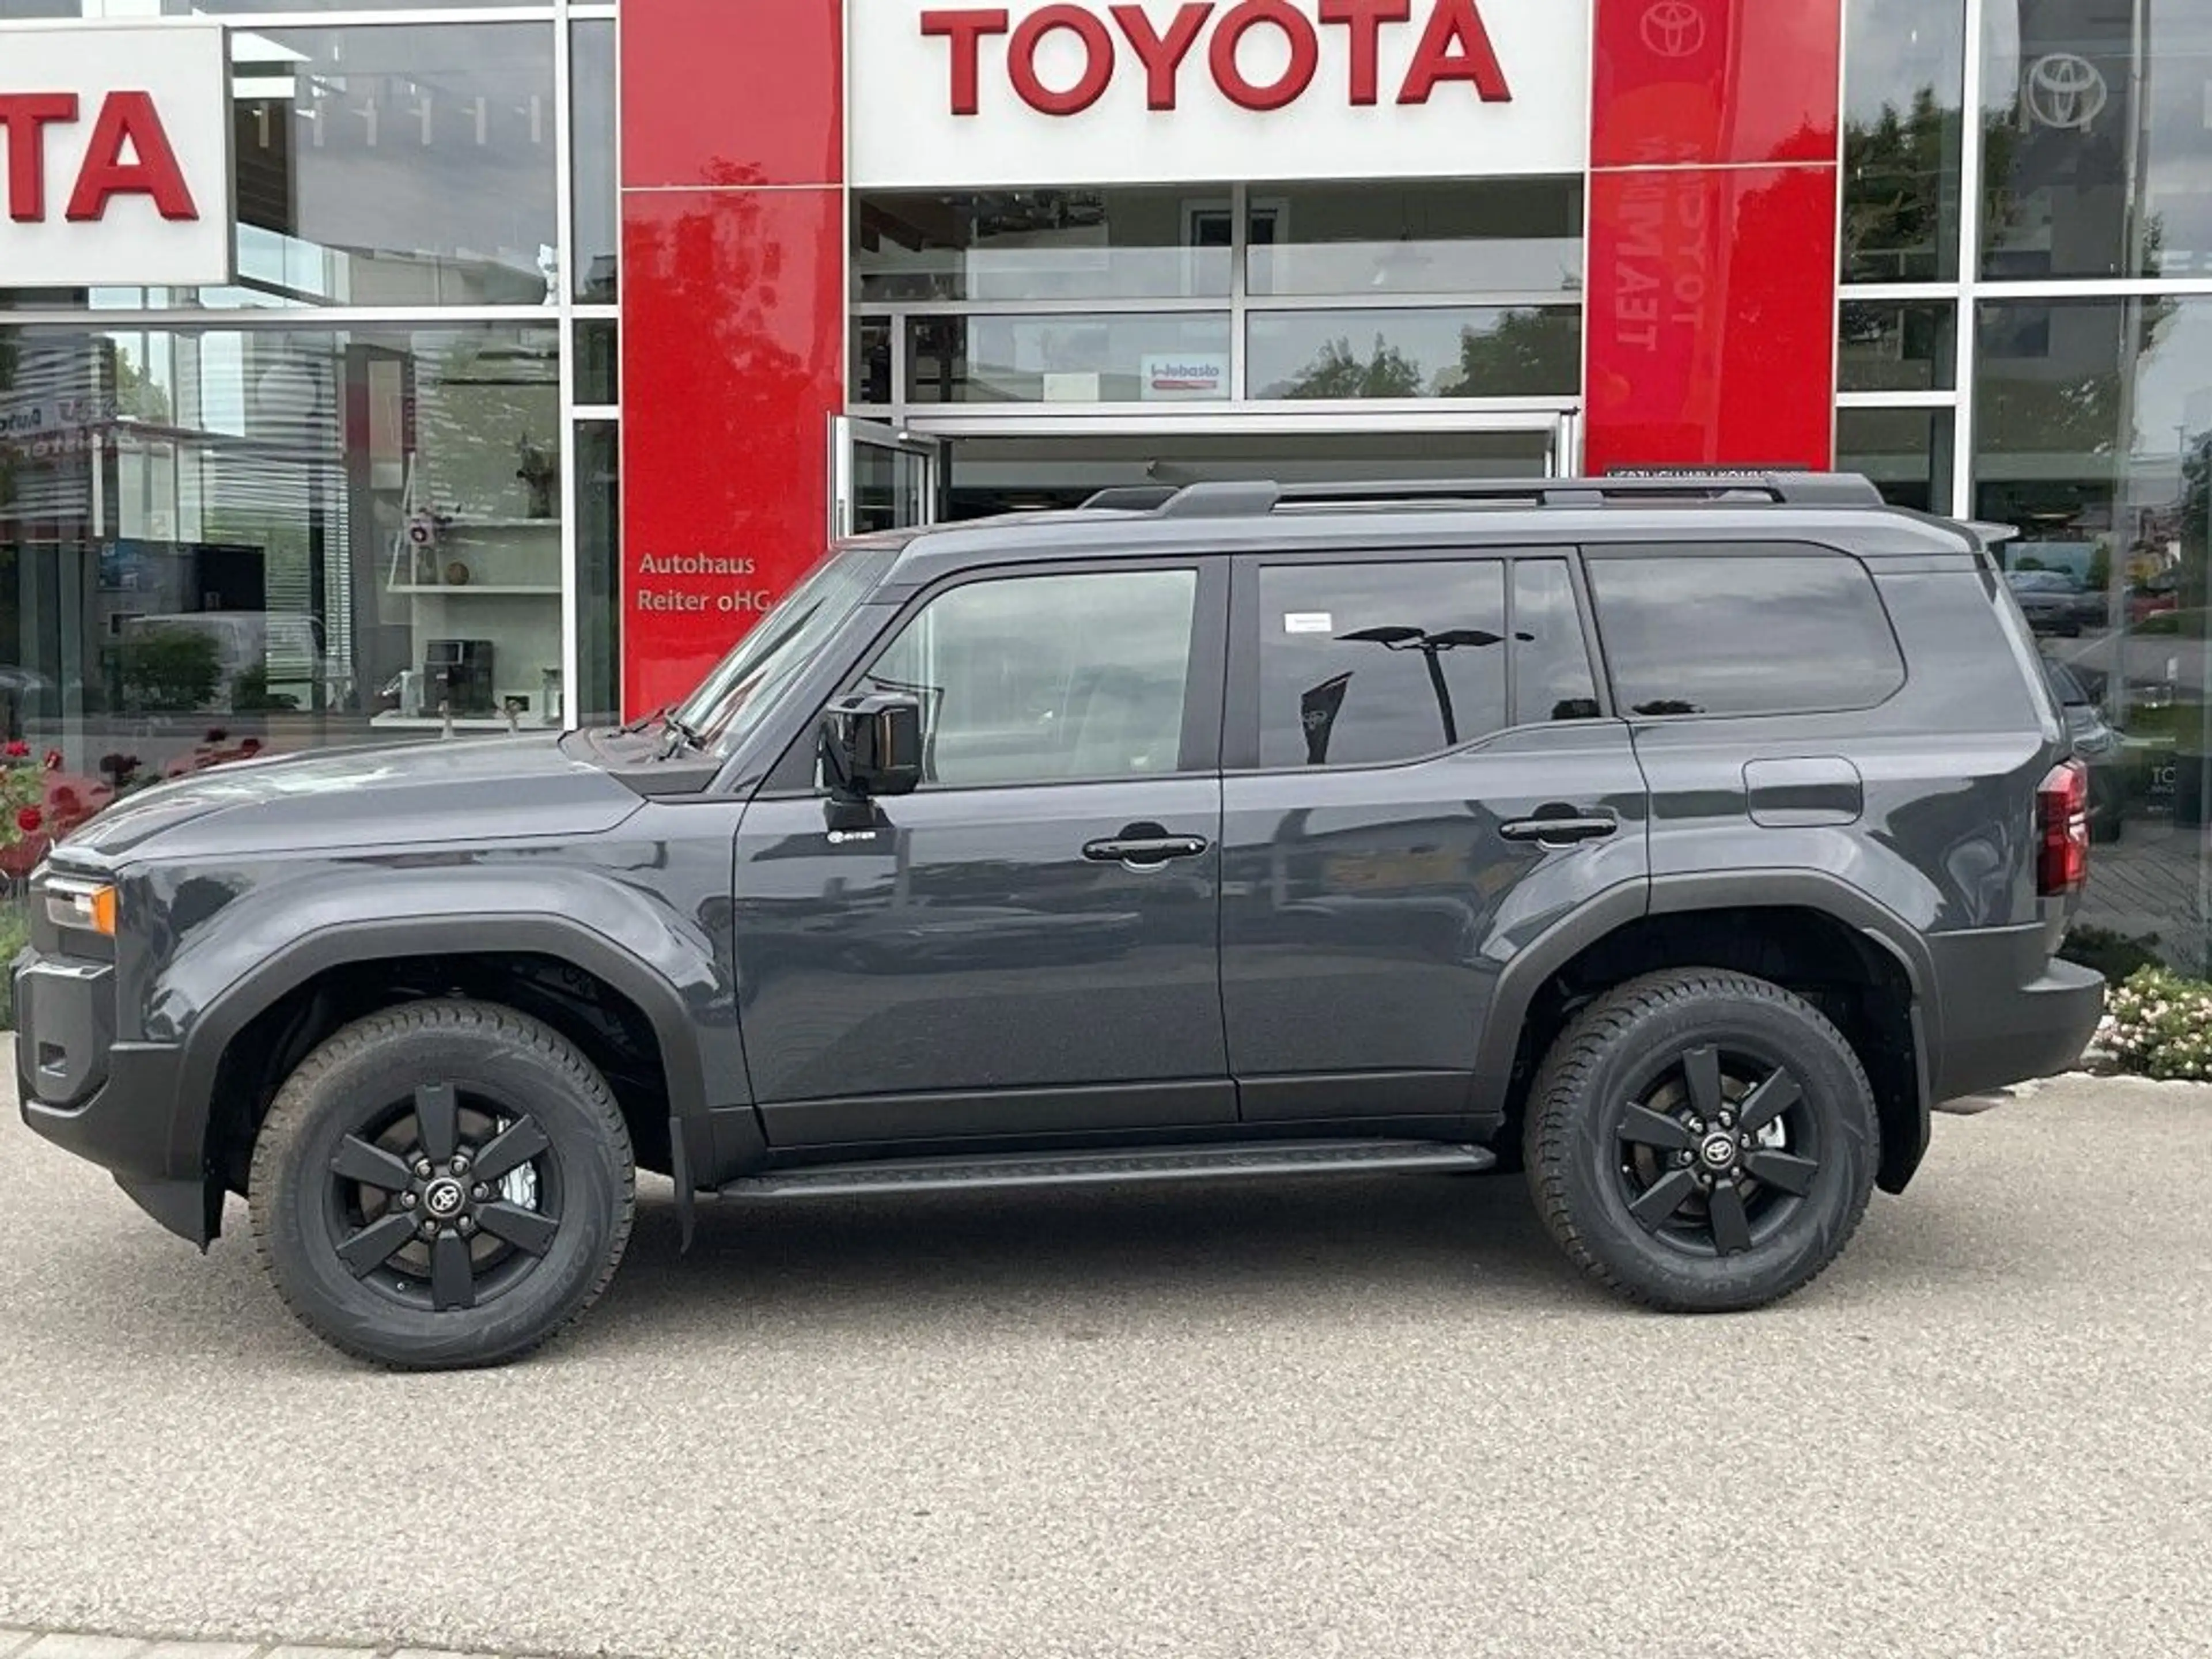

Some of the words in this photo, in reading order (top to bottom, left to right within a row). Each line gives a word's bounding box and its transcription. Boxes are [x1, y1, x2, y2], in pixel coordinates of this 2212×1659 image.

[921, 0, 1512, 115] TOYOTA
[639, 553, 755, 574] Autohaus
[638, 590, 710, 611] Reiter
